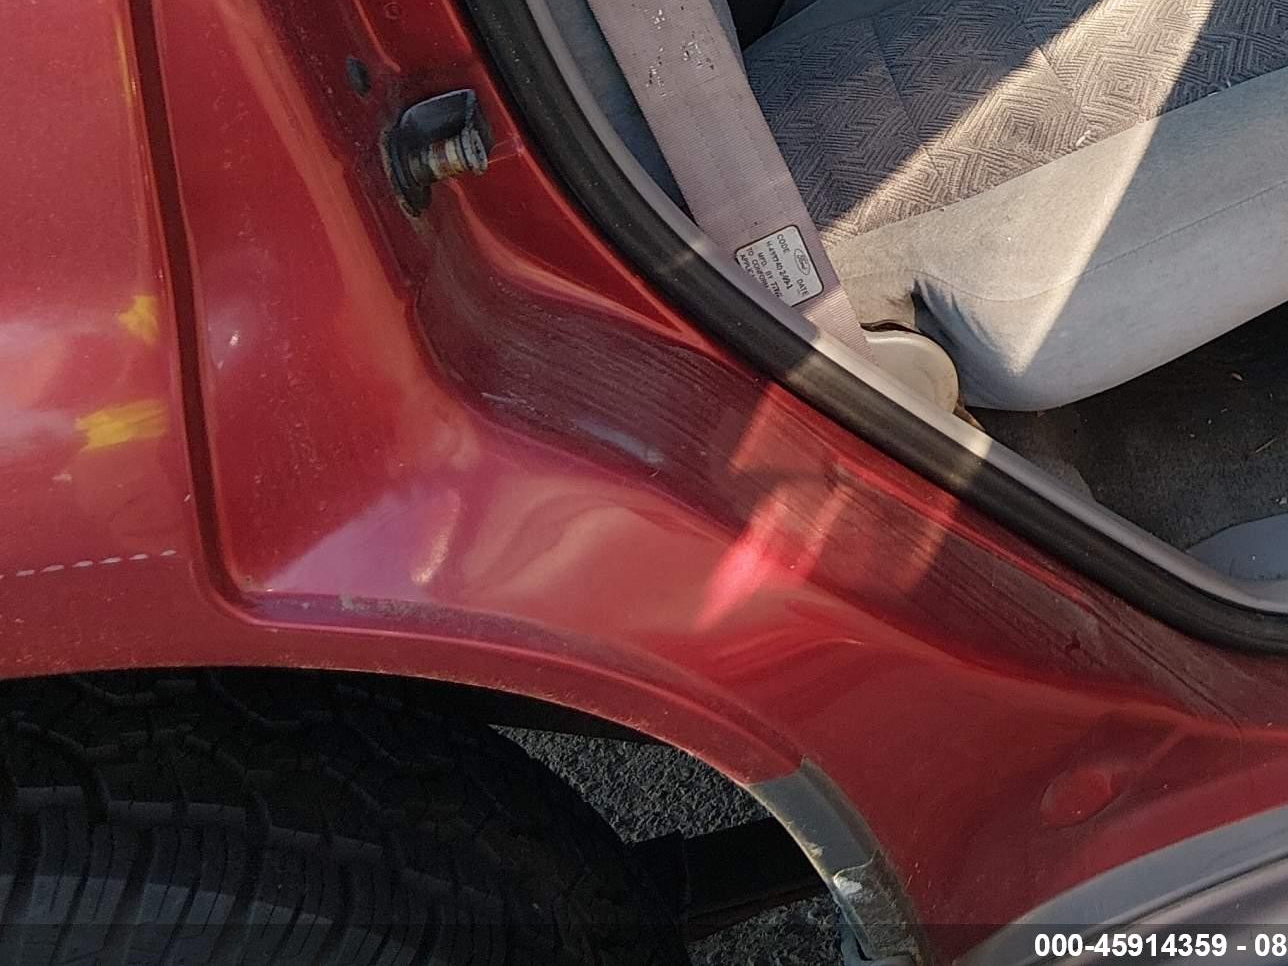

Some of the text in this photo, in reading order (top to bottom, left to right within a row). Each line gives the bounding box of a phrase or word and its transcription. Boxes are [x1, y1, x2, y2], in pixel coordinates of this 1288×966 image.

[746, 247, 754, 256] TO
[777, 233, 790, 253] CODE
[796, 278, 810, 296] DATE
